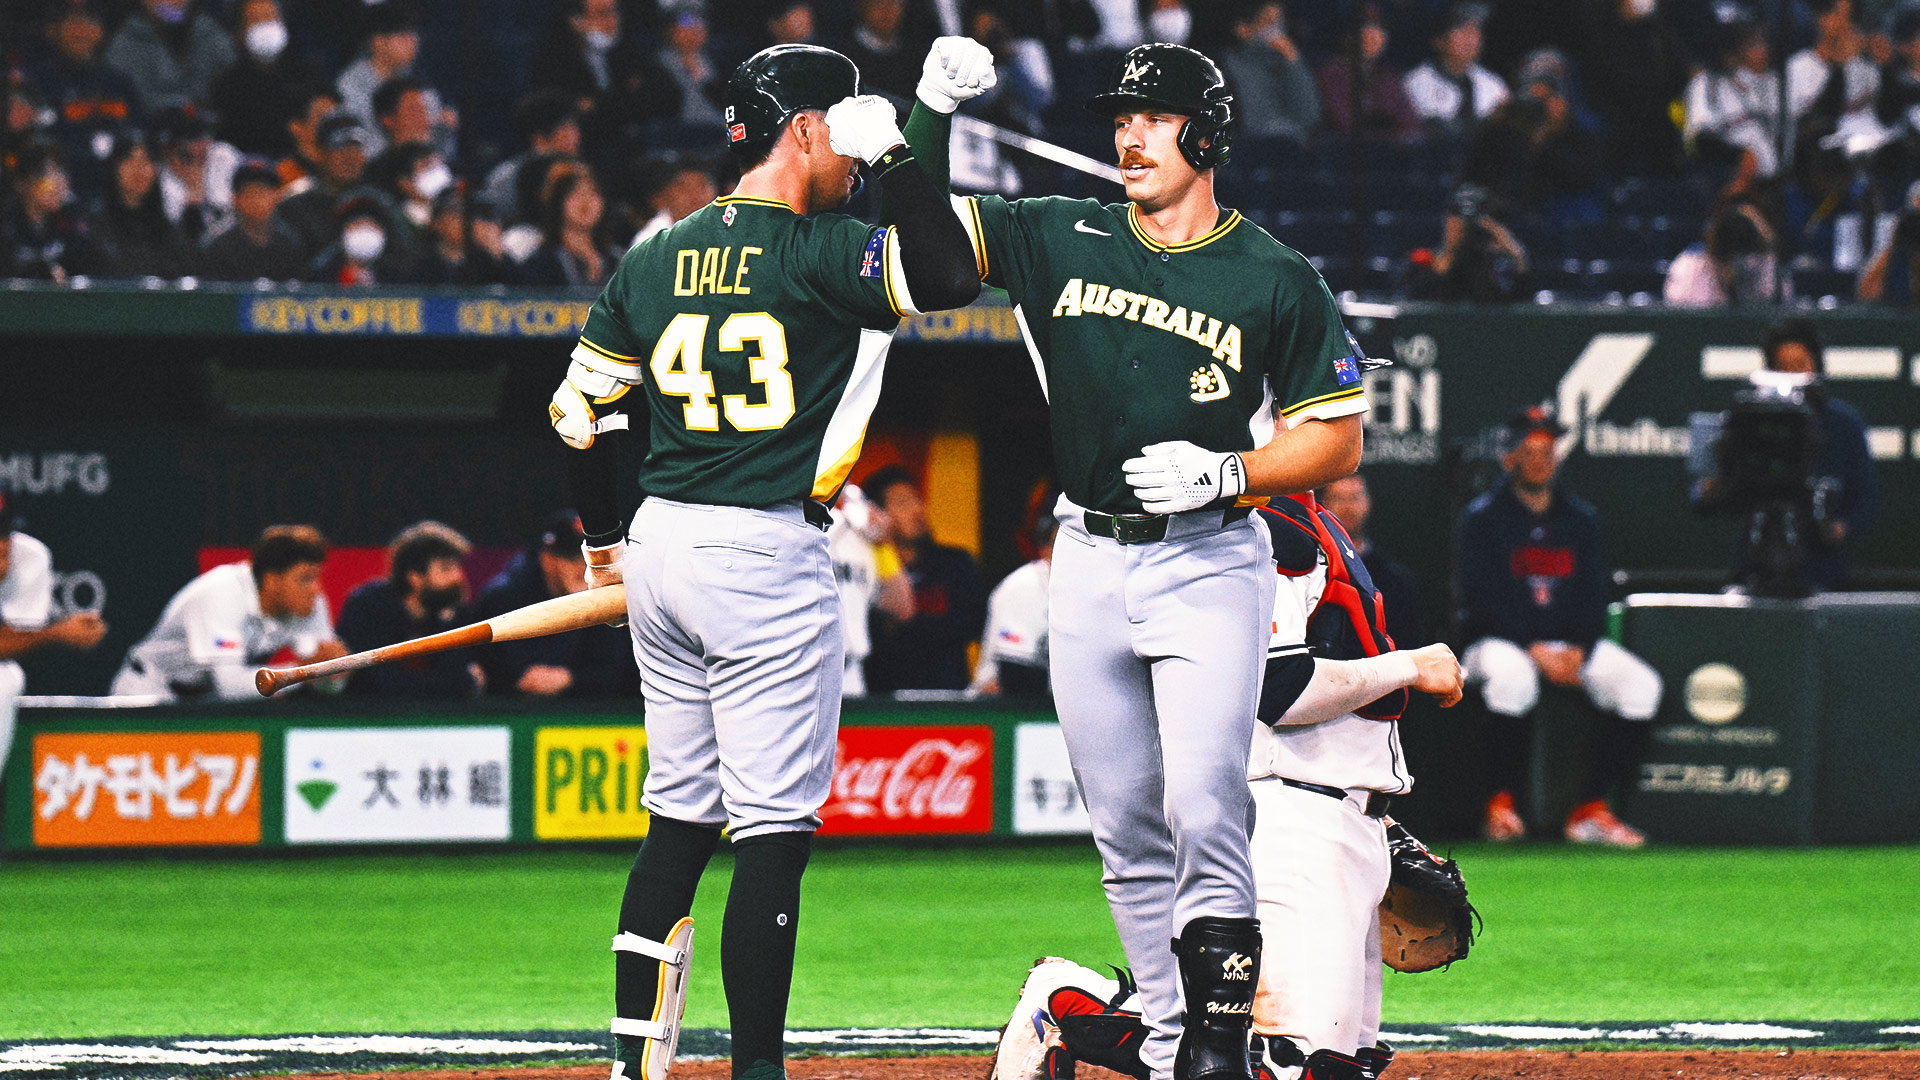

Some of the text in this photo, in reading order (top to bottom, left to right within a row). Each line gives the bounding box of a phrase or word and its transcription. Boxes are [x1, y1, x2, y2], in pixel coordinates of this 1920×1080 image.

[674, 246, 763, 296] DALE
[1052, 278, 1243, 373] AUSTRALIA
[649, 312, 796, 432] 43
[35, 752, 258, 820] タケモトピアノ
[1222, 970, 1251, 982] NINE
